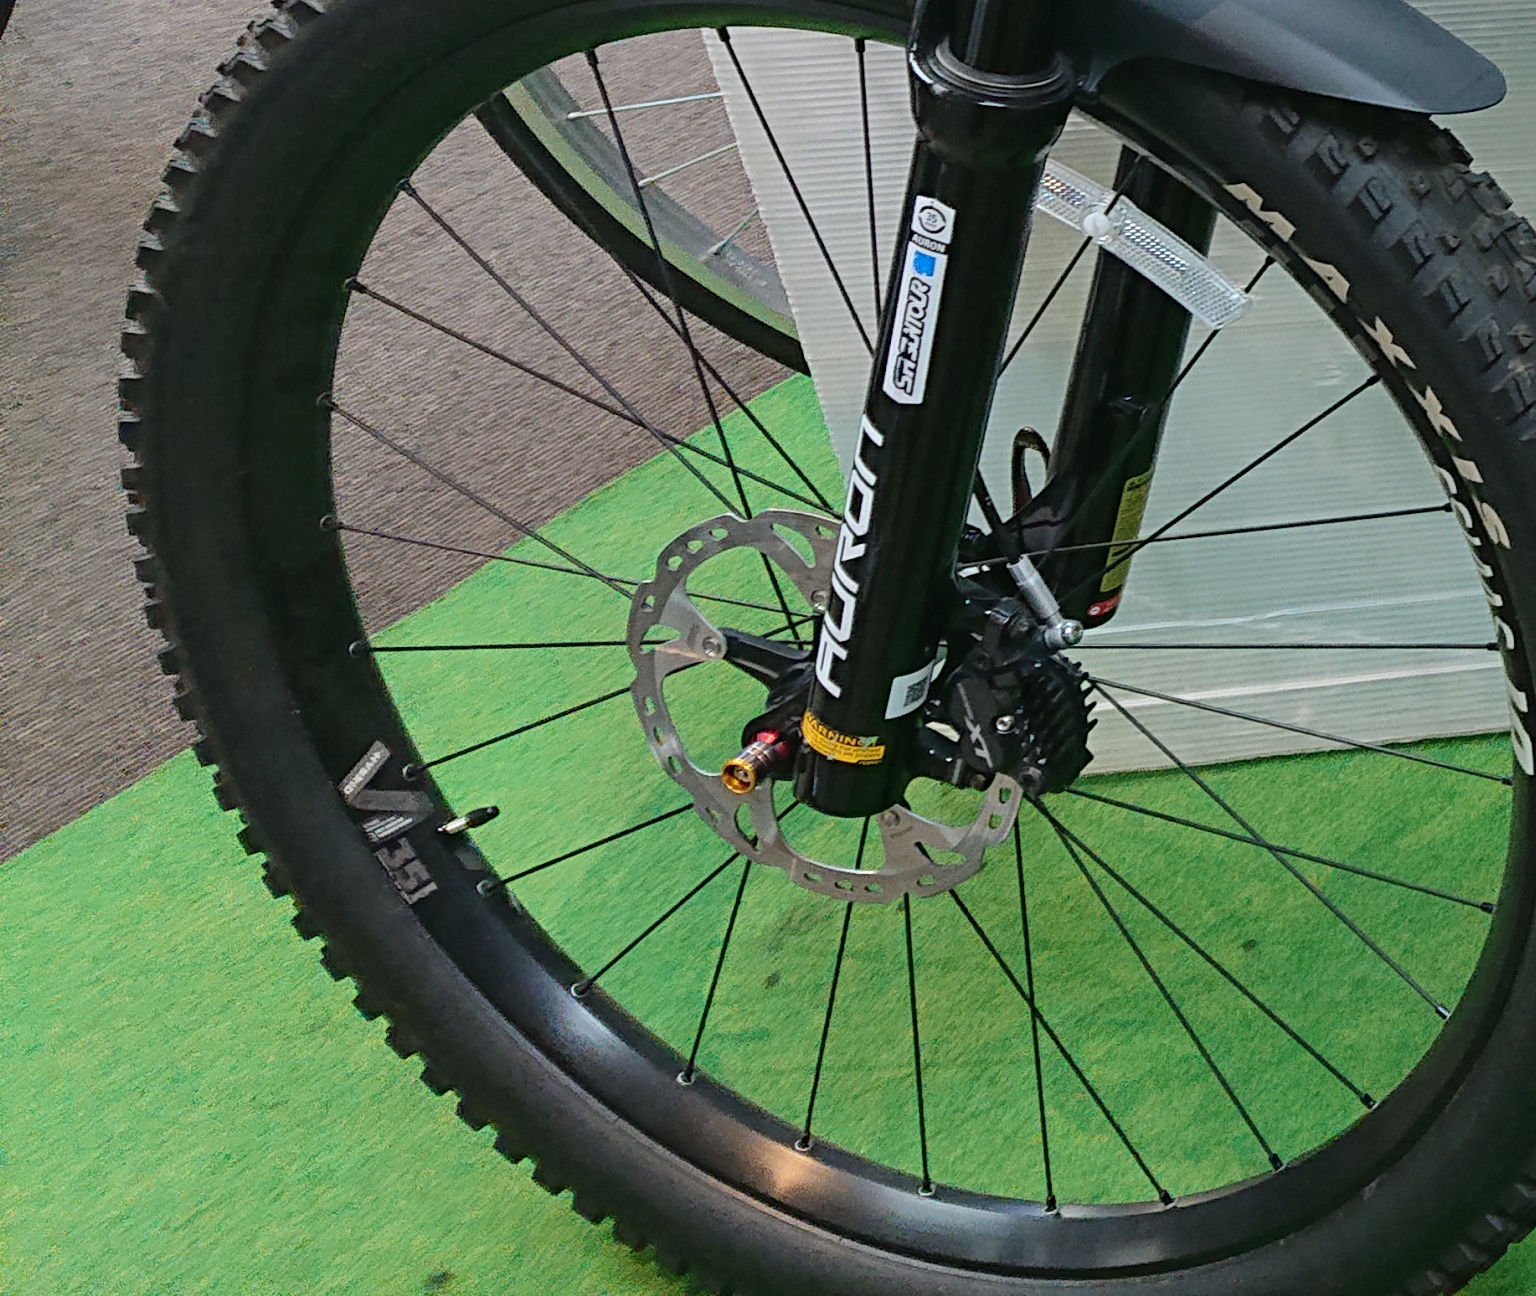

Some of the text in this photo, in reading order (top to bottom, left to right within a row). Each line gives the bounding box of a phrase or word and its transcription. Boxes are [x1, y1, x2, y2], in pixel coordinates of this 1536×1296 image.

[911, 233, 947, 254] AURON
[1222, 182, 1512, 550] MAXXIS
[815, 414, 885, 698] AURON
